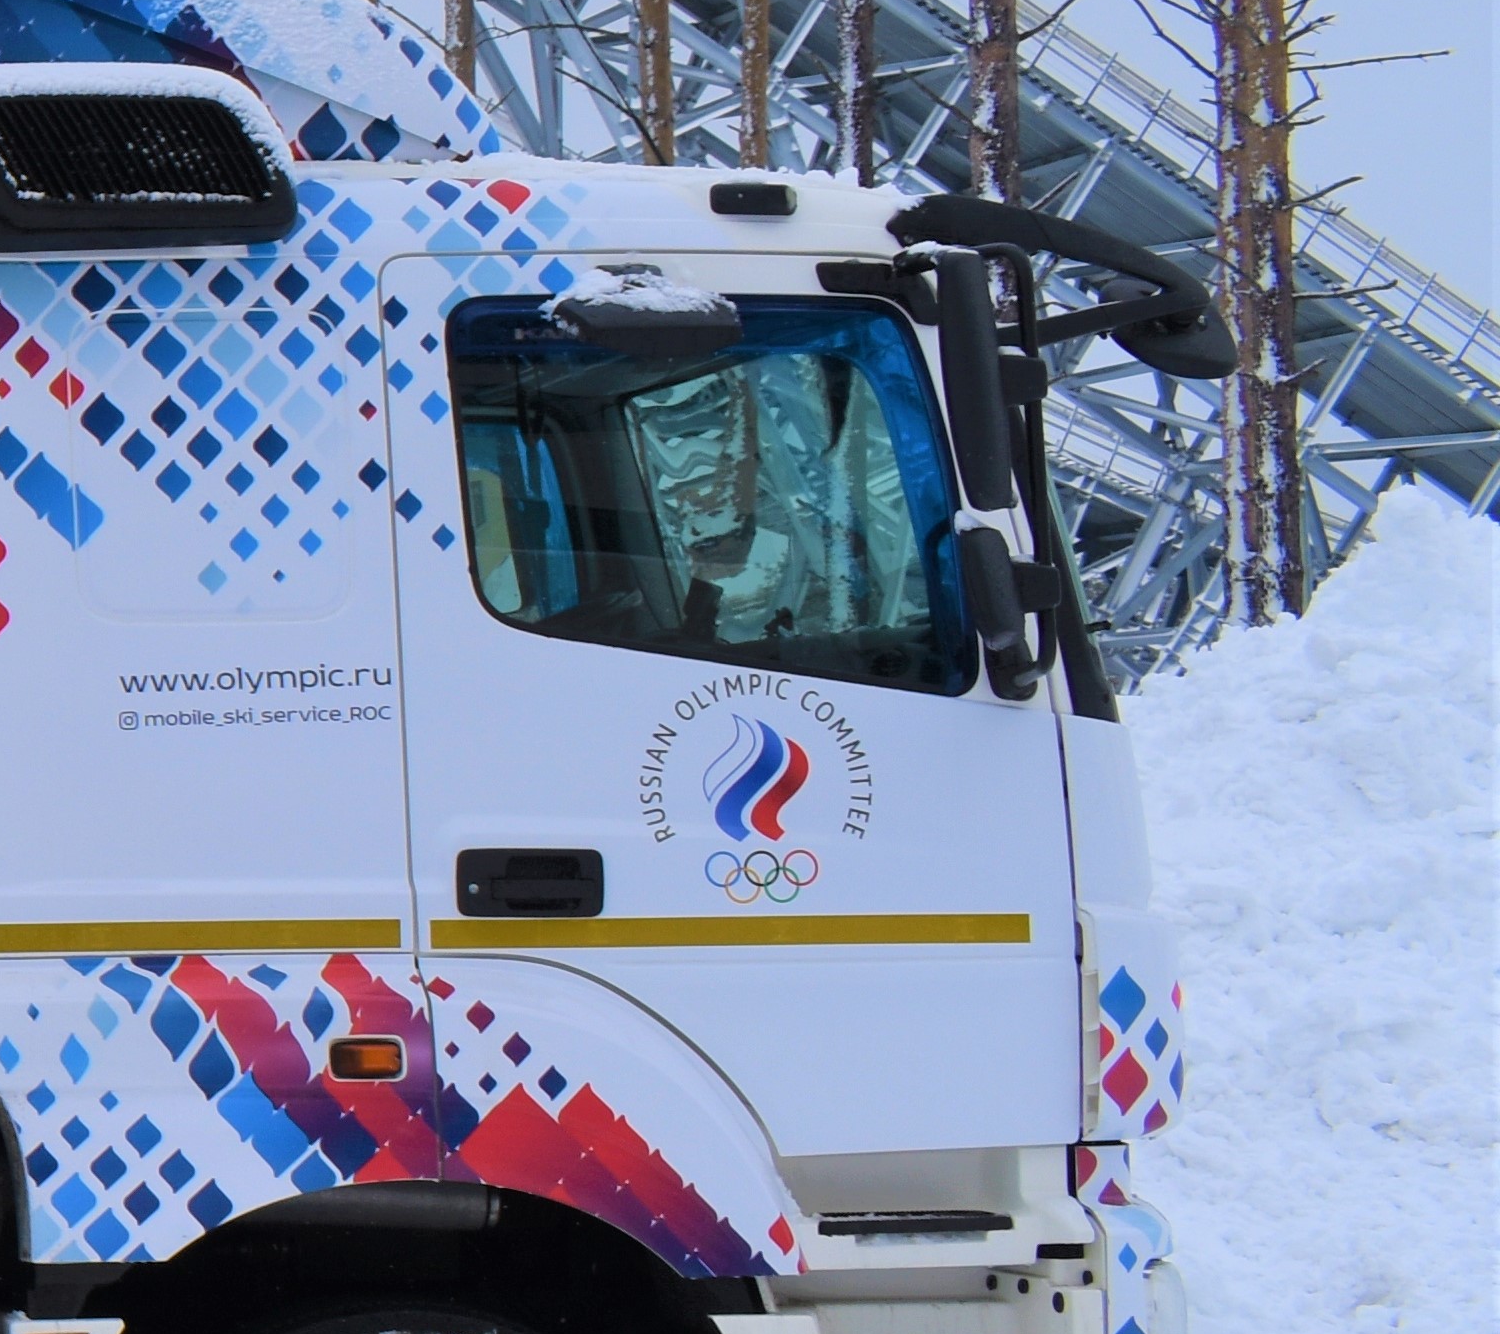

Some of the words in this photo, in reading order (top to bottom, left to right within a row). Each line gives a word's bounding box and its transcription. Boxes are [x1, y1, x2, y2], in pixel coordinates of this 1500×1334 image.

[119, 663, 392, 694] www.olympic.ru
[144, 705, 392, 727] mobile_ski_service_ROC
[640, 723, 678, 843] RUSSIAN
[674, 673, 792, 721] OLYMPIC
[800, 690, 873, 840] COMMITTEE
